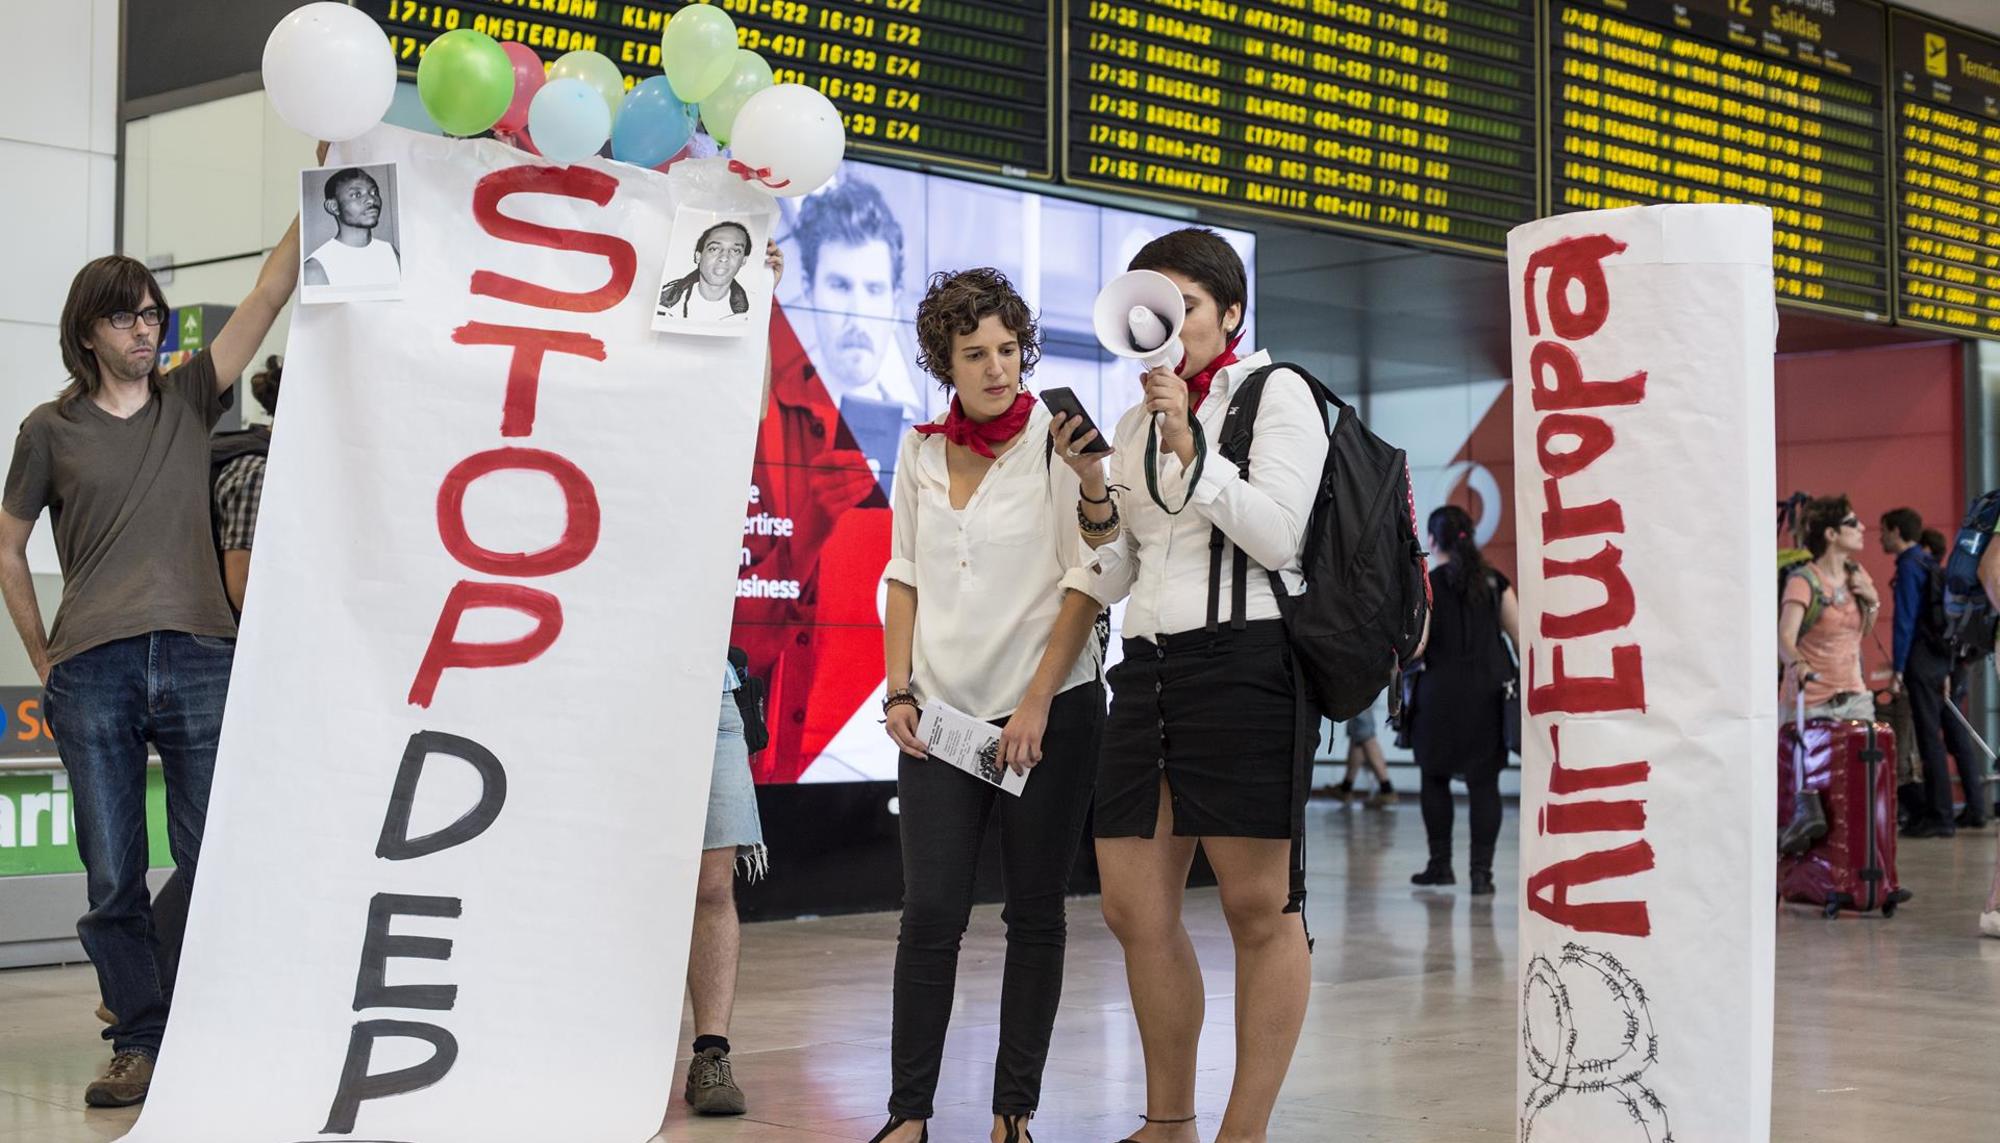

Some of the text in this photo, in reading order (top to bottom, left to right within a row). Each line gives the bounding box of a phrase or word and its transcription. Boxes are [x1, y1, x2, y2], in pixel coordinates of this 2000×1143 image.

[819, 9, 875, 37] 16:31
[885, 22, 921, 46] E72
[1090, 2, 1138, 27] 17:35
[1147, 15, 1211, 44] BADAJOZ
[1769, 4, 1821, 43] Salidas
[388, 0, 460, 30] 17:10
[473, 14, 598, 51] AMSTERDAM
[621, 40, 662, 66] ETD
[818, 76, 877, 104] 16:33
[885, 88, 921, 112] E74
[737, 27, 806, 58] 23-431
[818, 43, 877, 71] 16:33
[885, 55, 921, 79] E74
[1090, 33, 1138, 57] 17:35
[1147, 46, 1220, 76] BRUSELAS
[1090, 63, 1138, 88] 17:35
[1147, 76, 1220, 105] BRUSELAS
[885, 120, 921, 143] E74
[1090, 94, 1138, 118] 17:35
[1147, 106, 1220, 135] BRUSELAS
[1090, 125, 1137, 149] 17:50
[1147, 136, 1220, 164] ROMA-FCO
[1090, 156, 1138, 179] 17:55
[1147, 166, 1230, 194] FRANKFURT
[408, 164, 638, 709] STOP
[743, 512, 793, 537] ertirse
[735, 574, 800, 599] usiness
